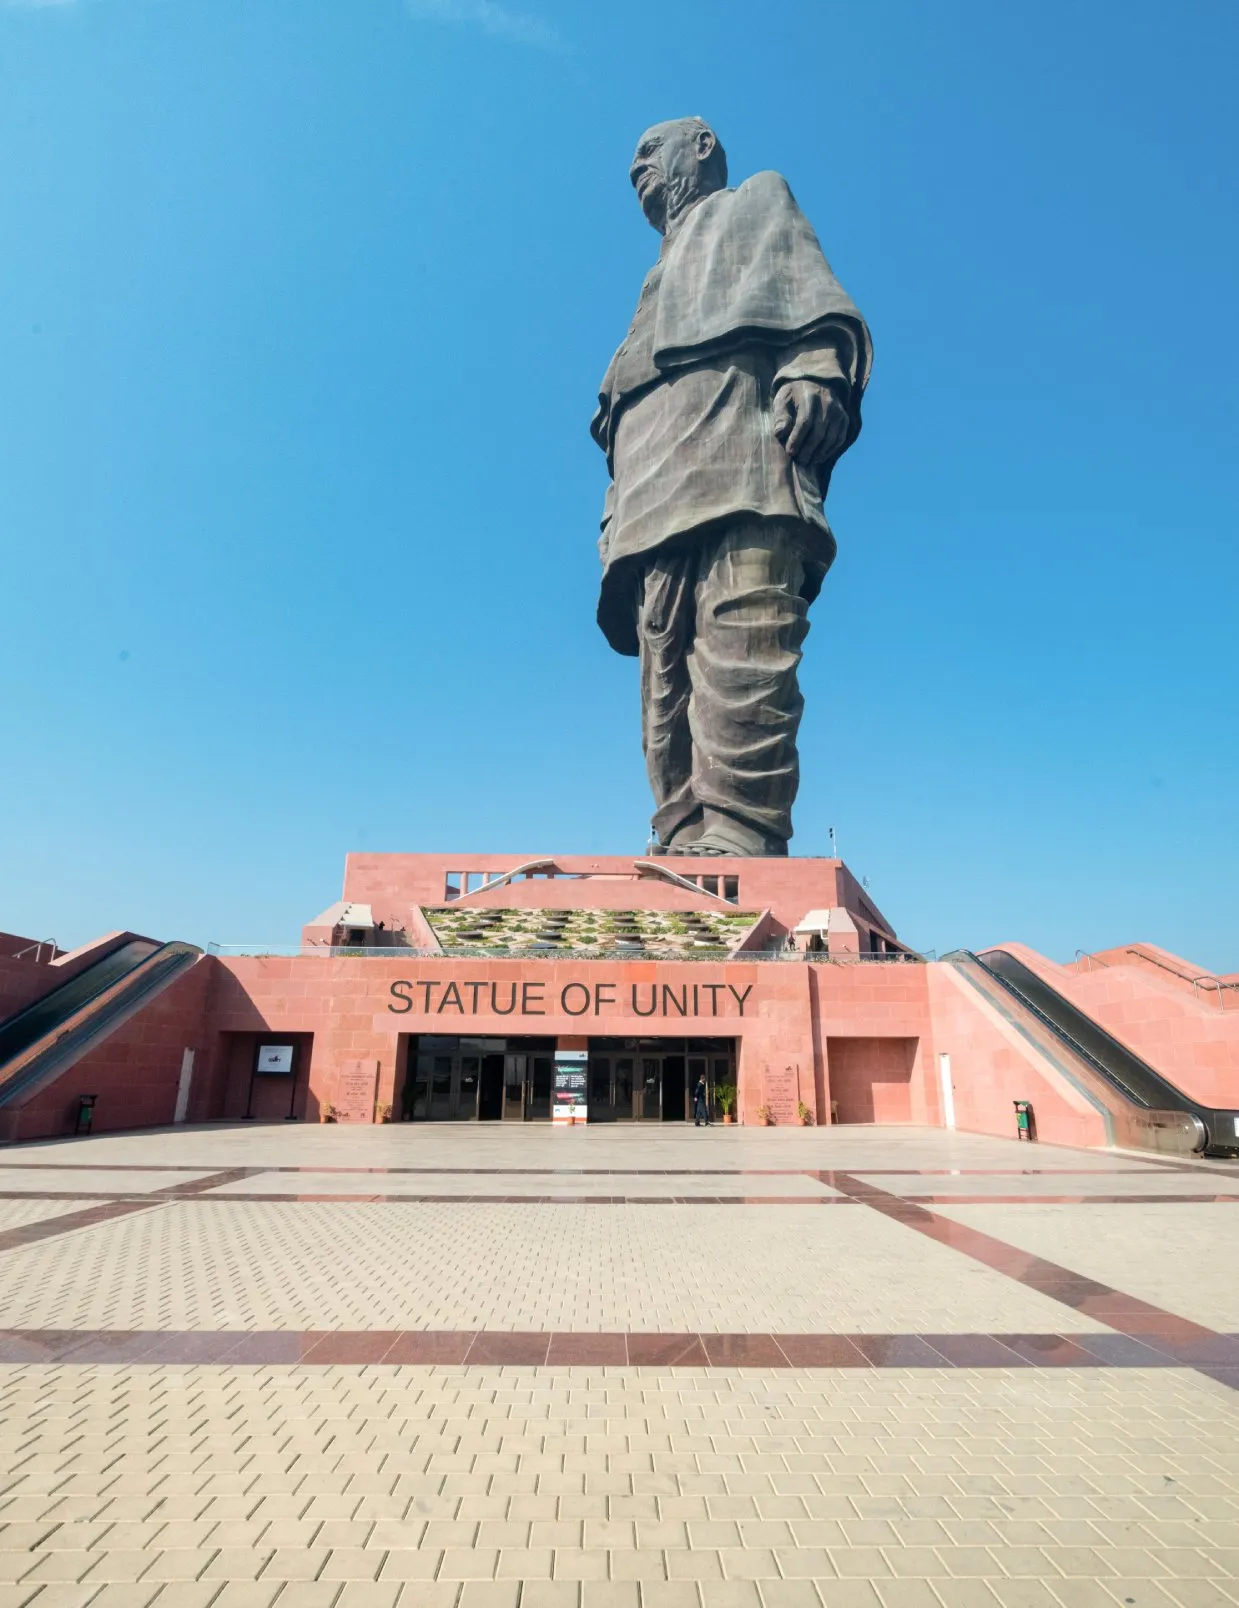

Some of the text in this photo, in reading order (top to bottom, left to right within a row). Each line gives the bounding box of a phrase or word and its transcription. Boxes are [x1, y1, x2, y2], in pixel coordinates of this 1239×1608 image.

[387, 980, 754, 1017] STATUE OF UNITY
